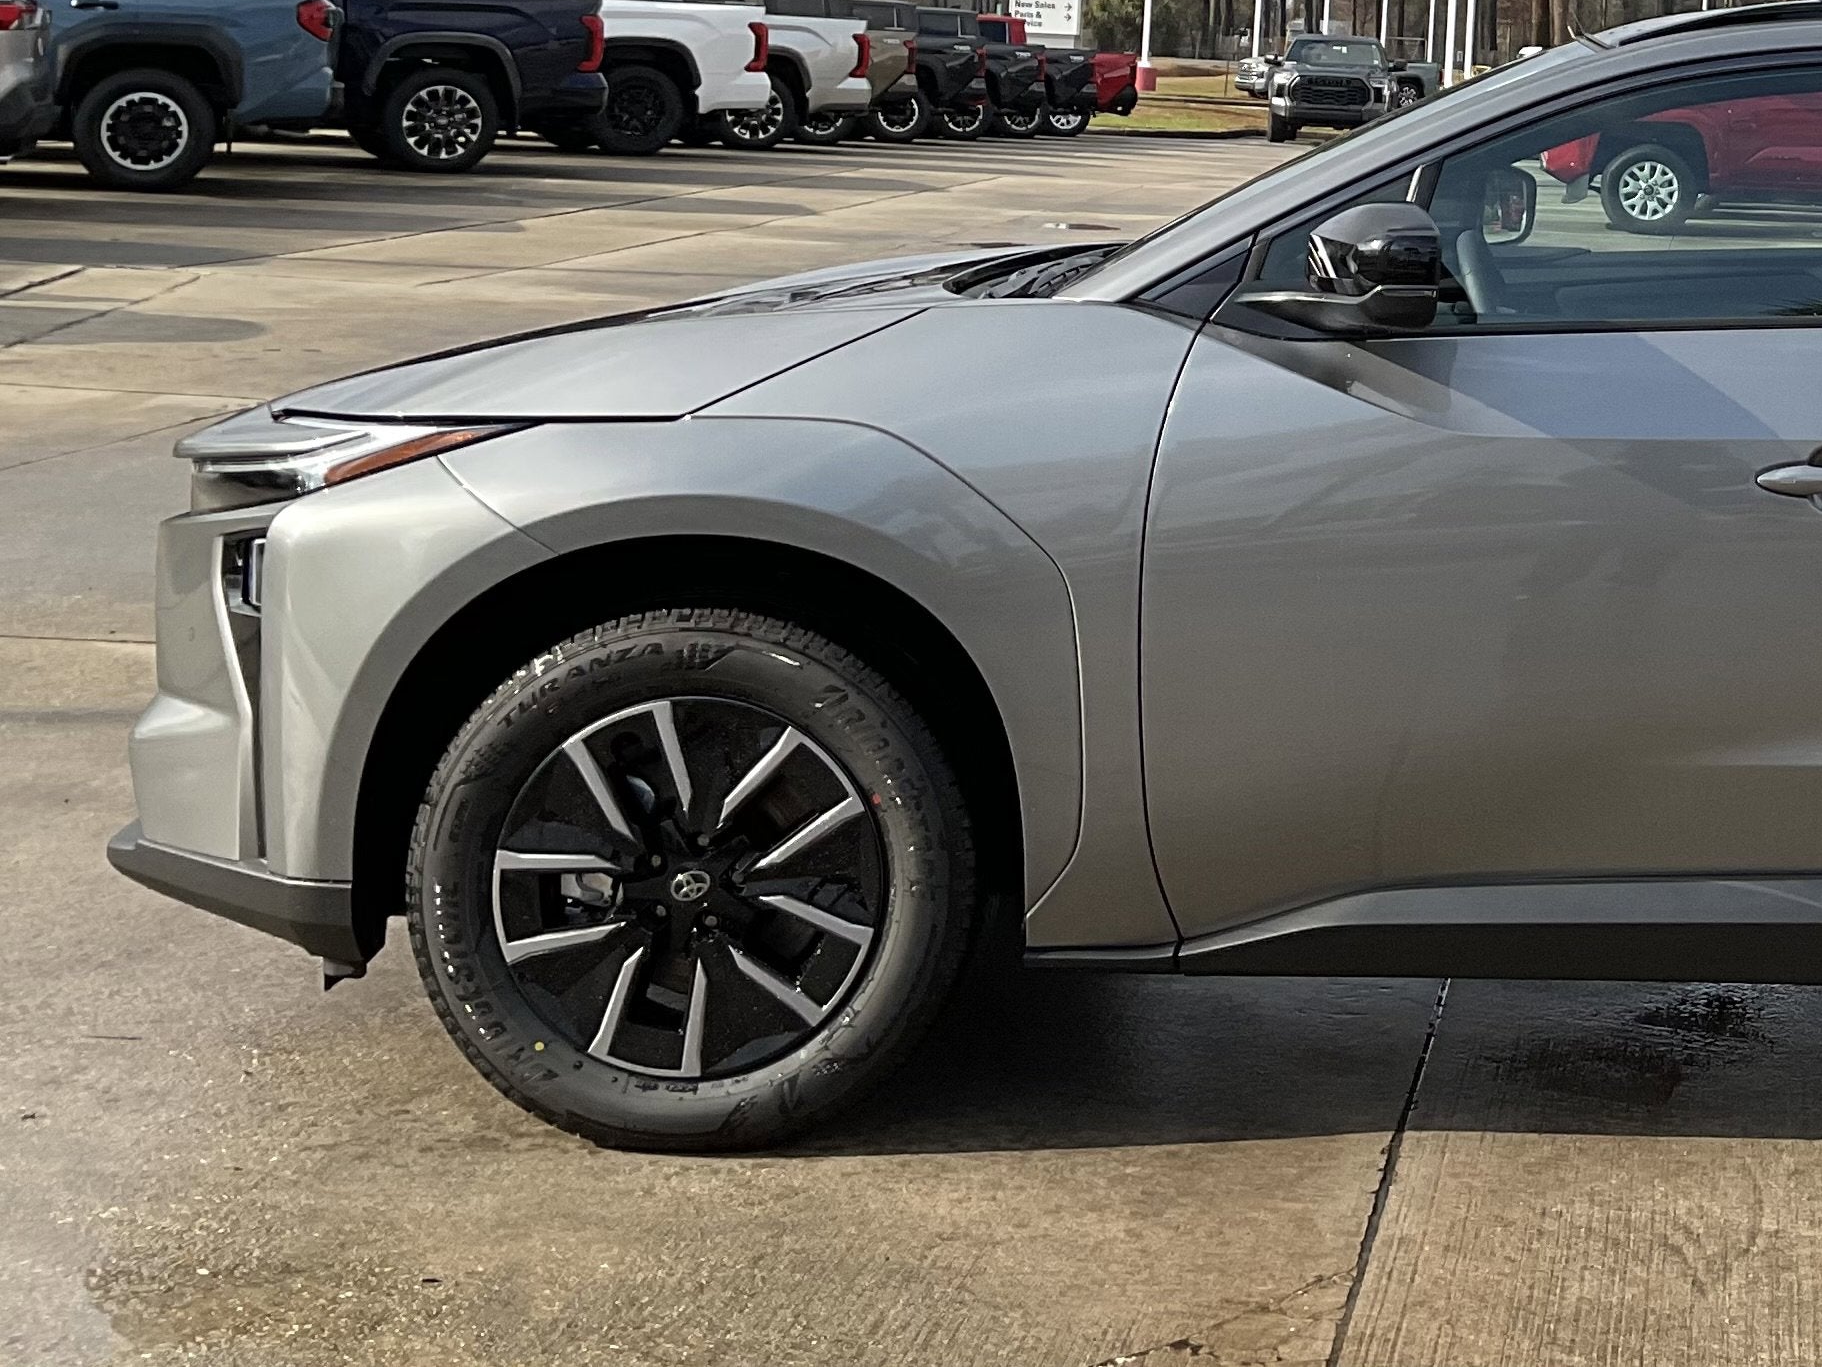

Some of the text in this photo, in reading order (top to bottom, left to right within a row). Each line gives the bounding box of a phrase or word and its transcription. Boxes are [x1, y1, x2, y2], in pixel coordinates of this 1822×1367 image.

[1014, 0, 1056, 9] New Sales
[1014, 10, 1042, 19] Parts &
[496, 642, 664, 729] TURANZA
